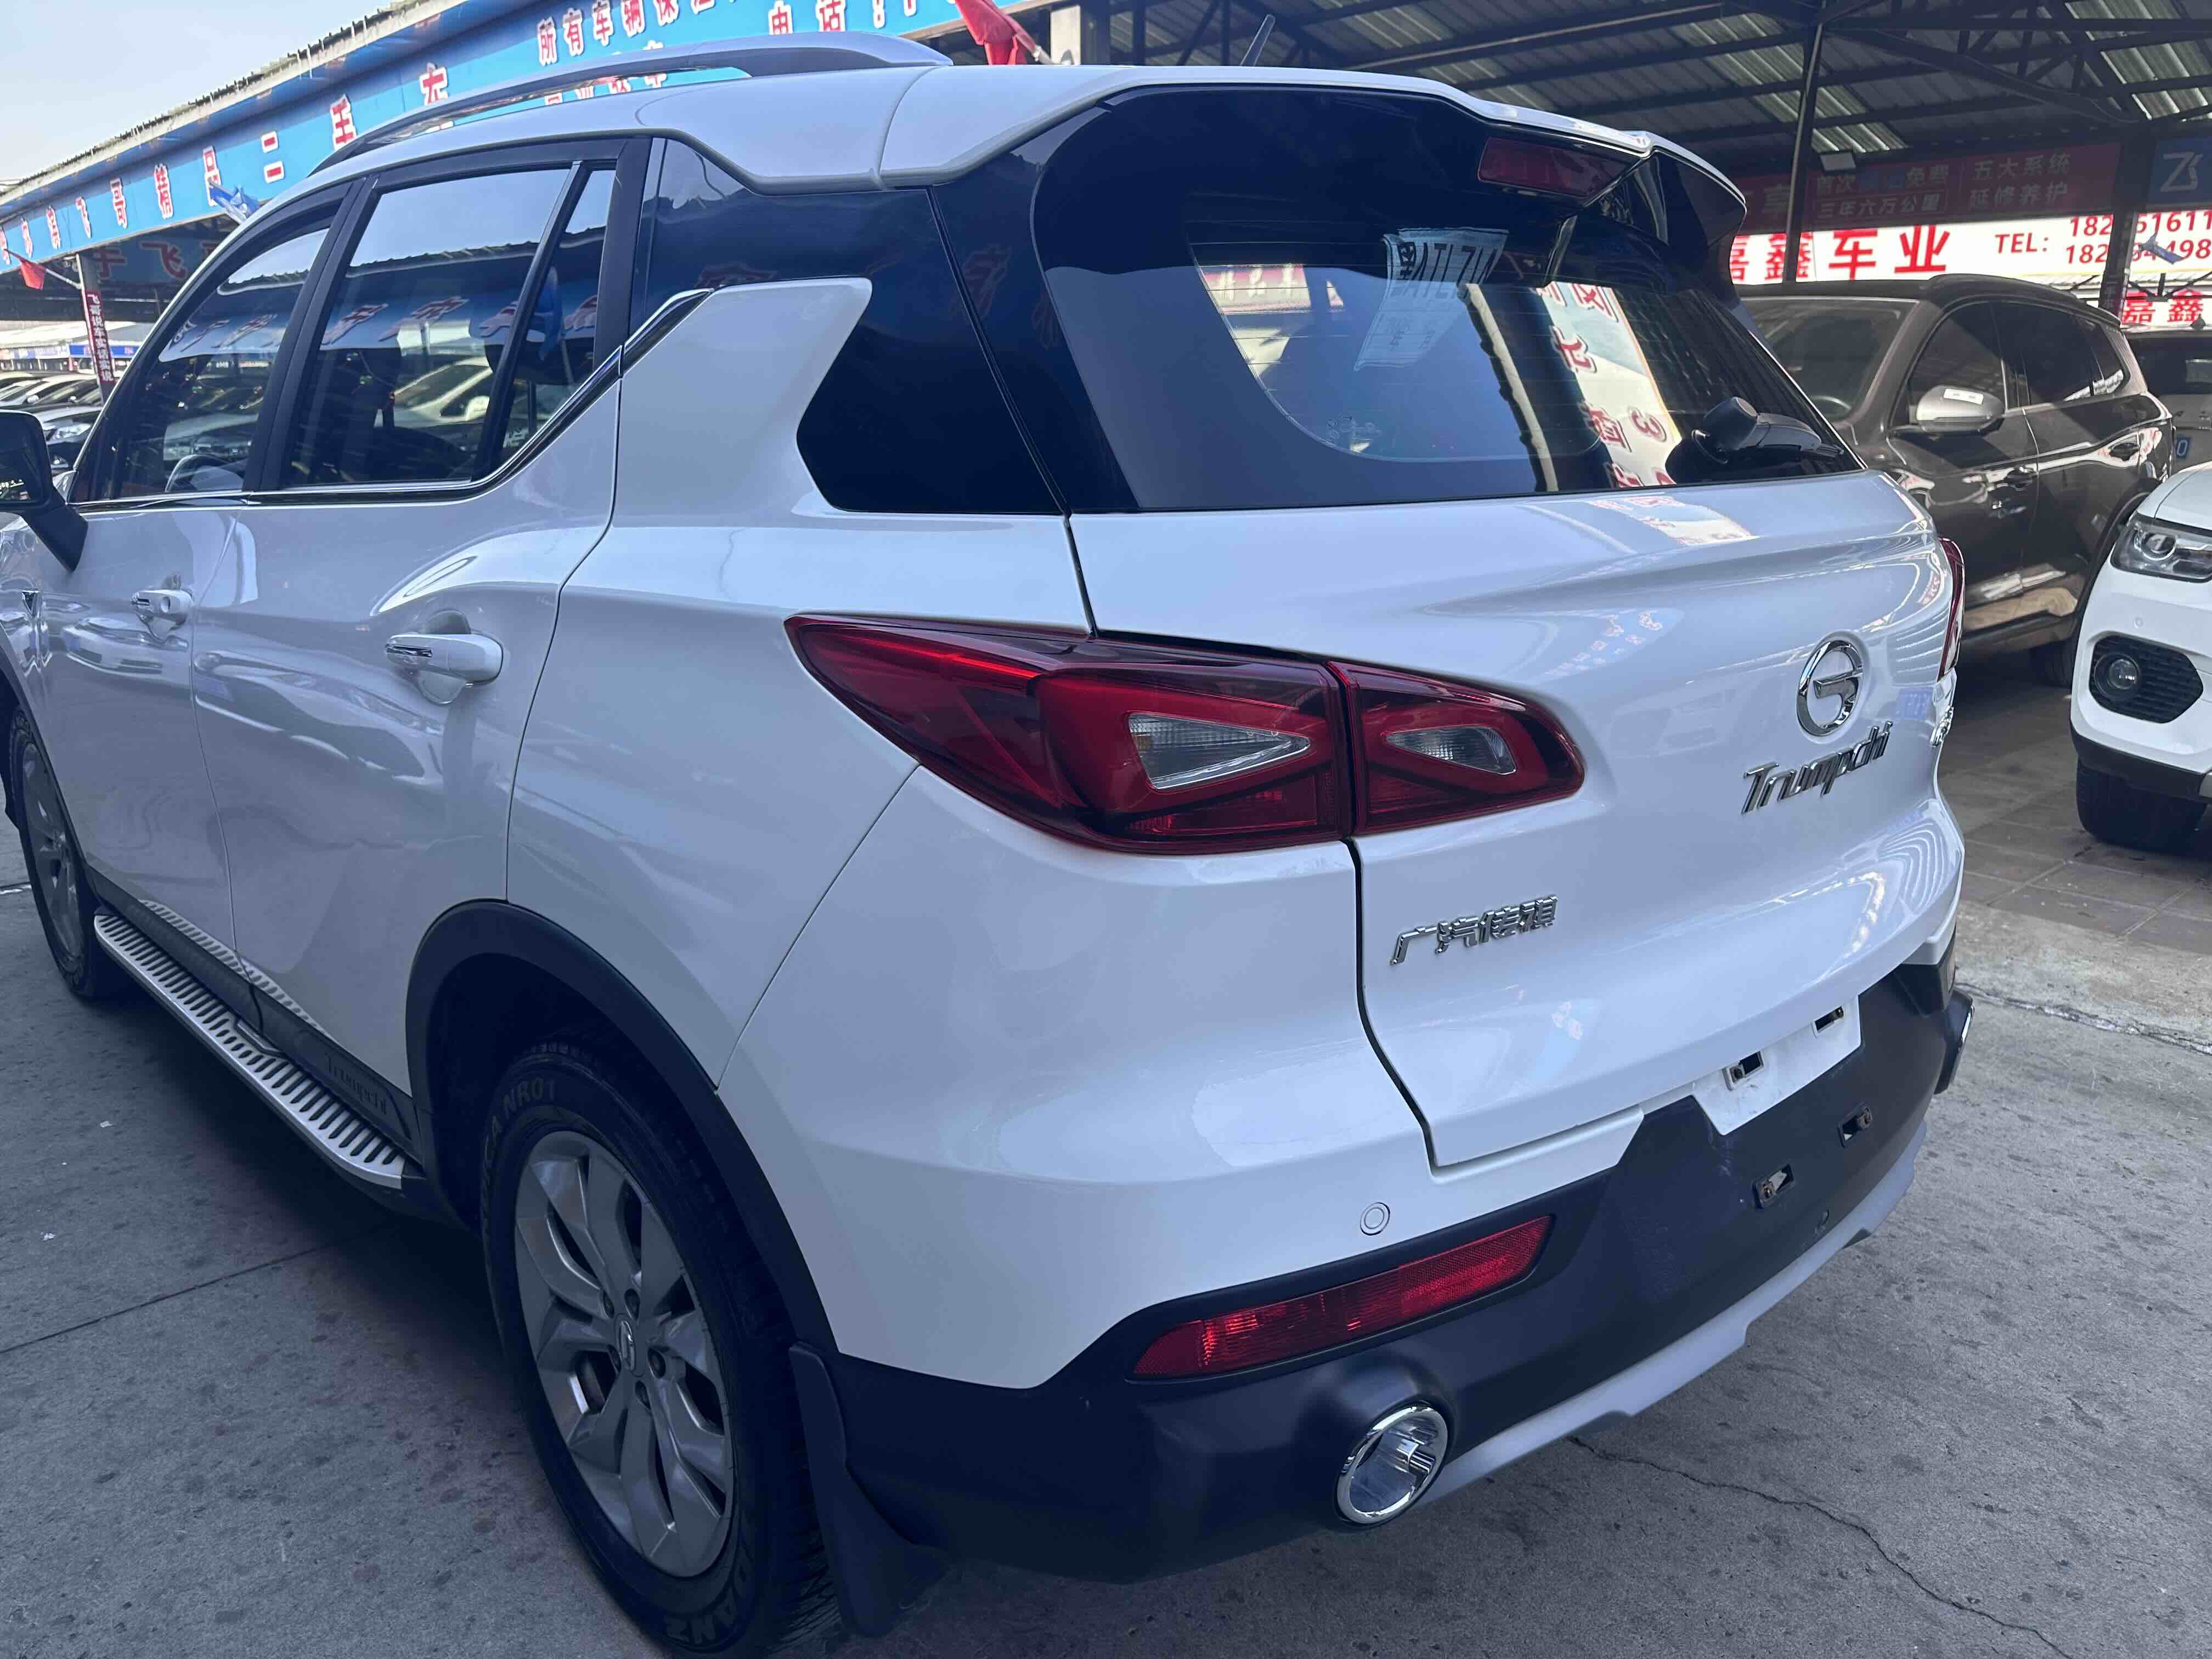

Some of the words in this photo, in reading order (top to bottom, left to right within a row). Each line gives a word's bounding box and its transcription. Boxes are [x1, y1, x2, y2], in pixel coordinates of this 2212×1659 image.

[1995, 233, 2049, 253] TEL:
[1741, 720, 1893, 815] Trumpchi
[1389, 894, 1559, 967] 广汽传祺
